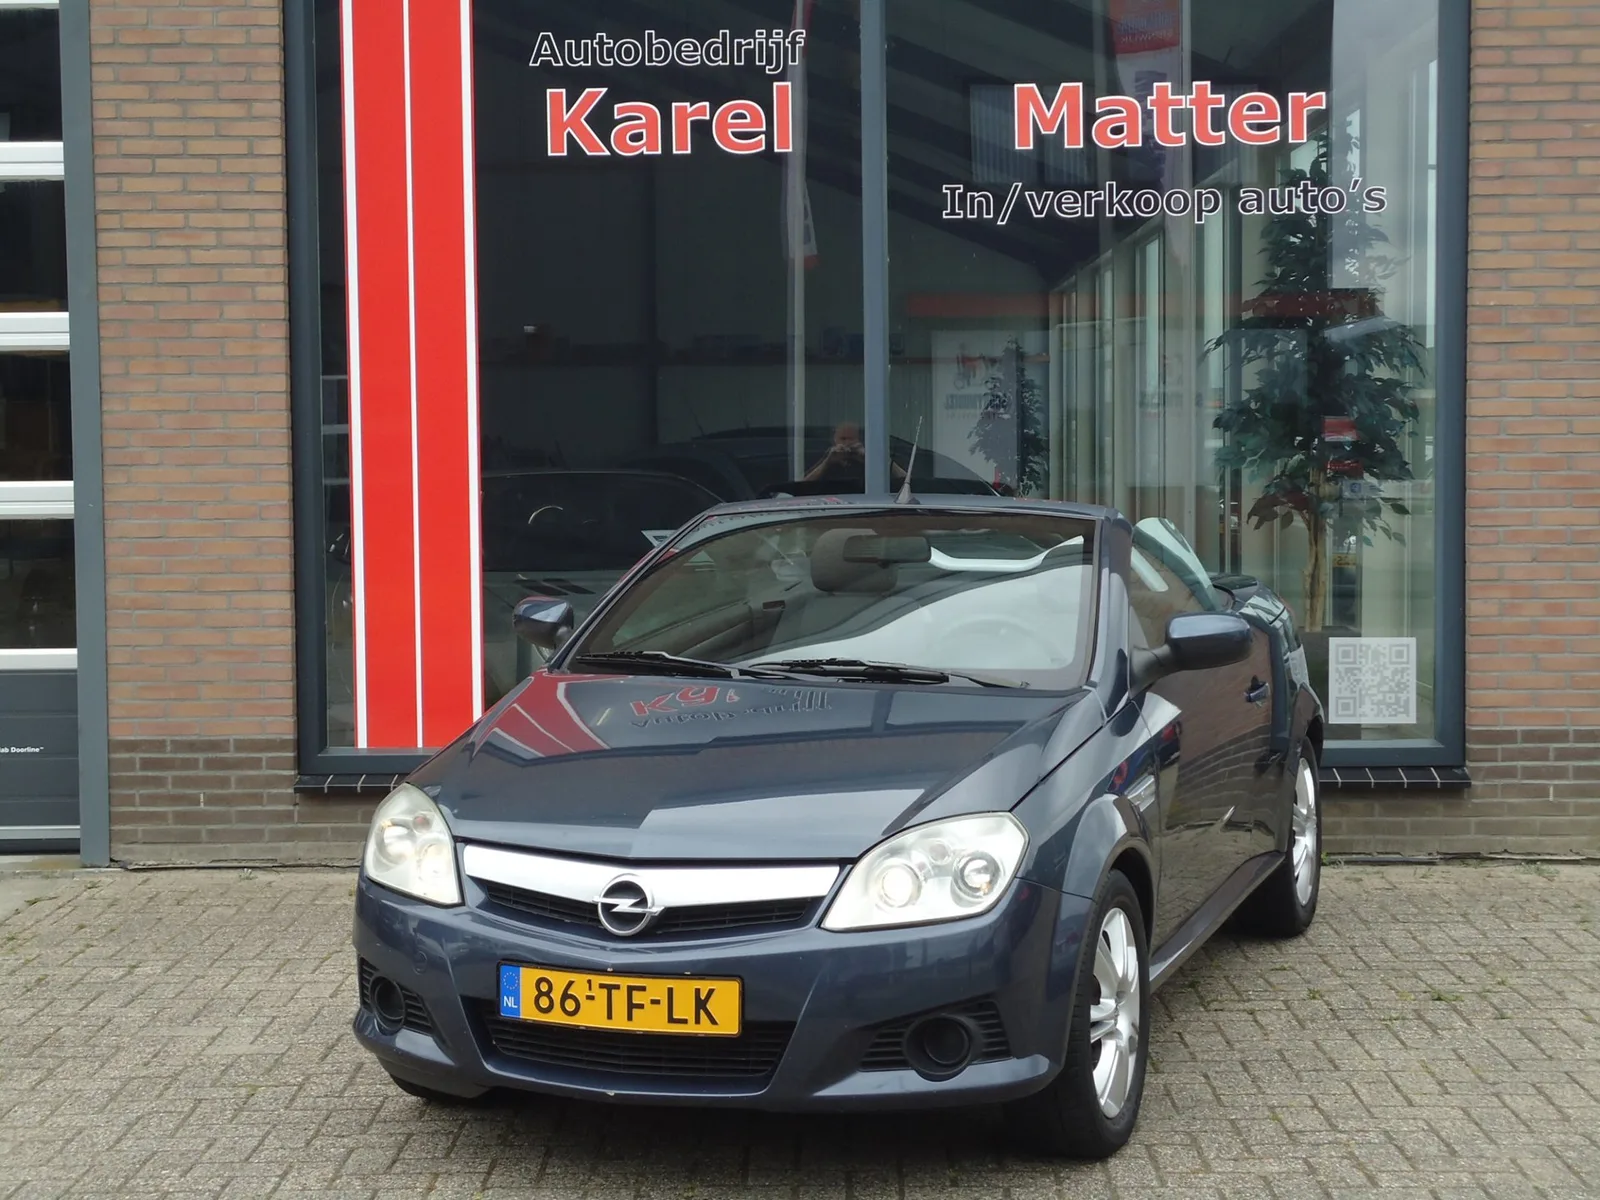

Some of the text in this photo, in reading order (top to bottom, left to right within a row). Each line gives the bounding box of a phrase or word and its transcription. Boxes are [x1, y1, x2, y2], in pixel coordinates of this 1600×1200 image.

[529, 29, 806, 74] Autobedrijf
[546, 82, 793, 156] Karel
[1013, 80, 1327, 151] Matter
[941, 182, 1222, 225] In/verkoop
[503, 996, 518, 1008] NL
